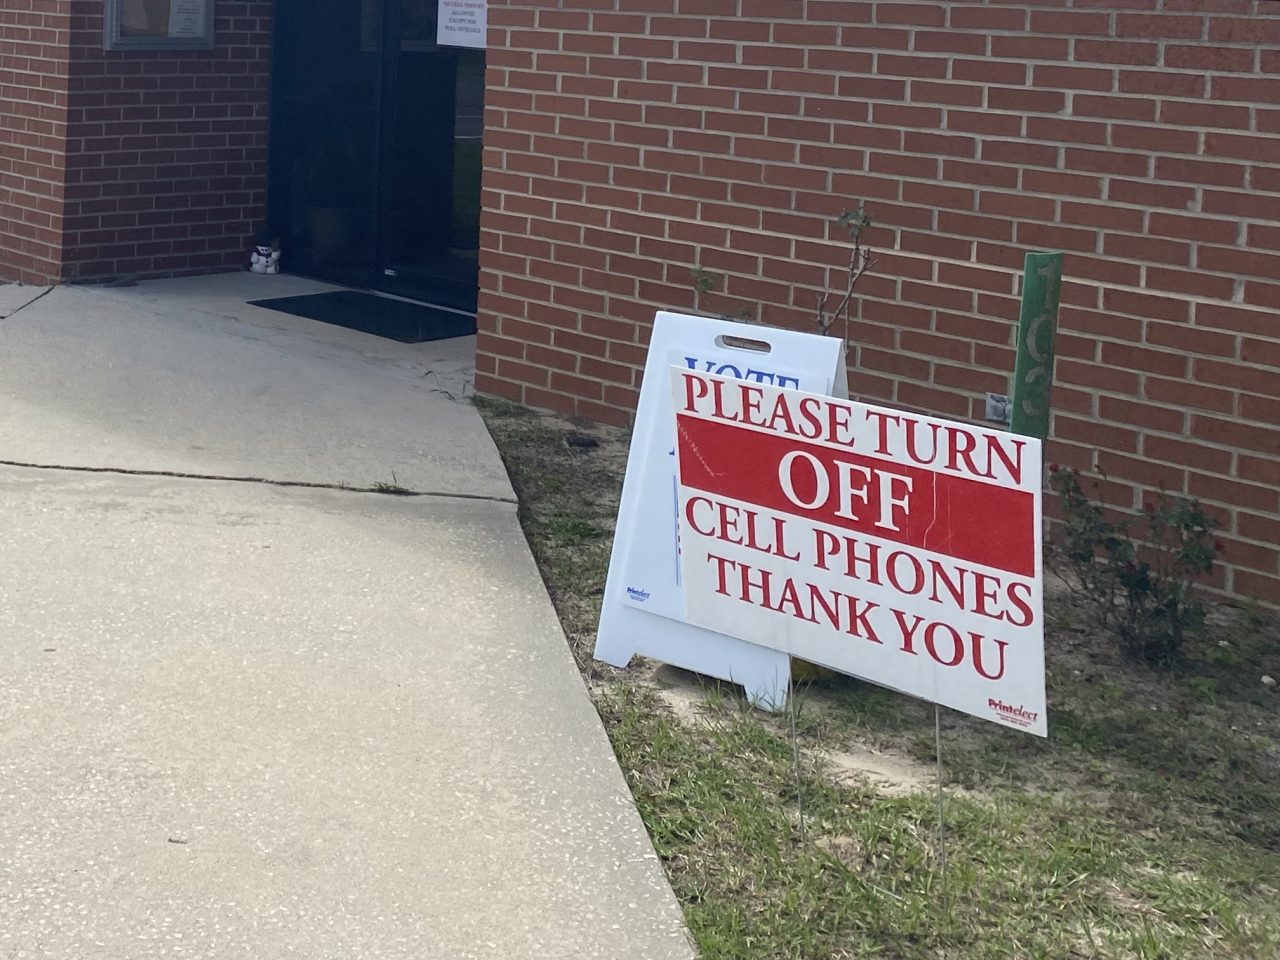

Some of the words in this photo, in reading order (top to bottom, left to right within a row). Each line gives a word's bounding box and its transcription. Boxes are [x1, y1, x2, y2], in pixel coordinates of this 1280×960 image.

[681, 373, 855, 448] PLEASE
[865, 409, 1027, 485] TURN
[778, 450, 914, 532] OFF
[685, 496, 801, 562] CELL
[813, 528, 1034, 627] PHONES
[707, 552, 884, 645] THANK
[890, 607, 1009, 680] YOU
[988, 698, 1038, 721] Printelect
